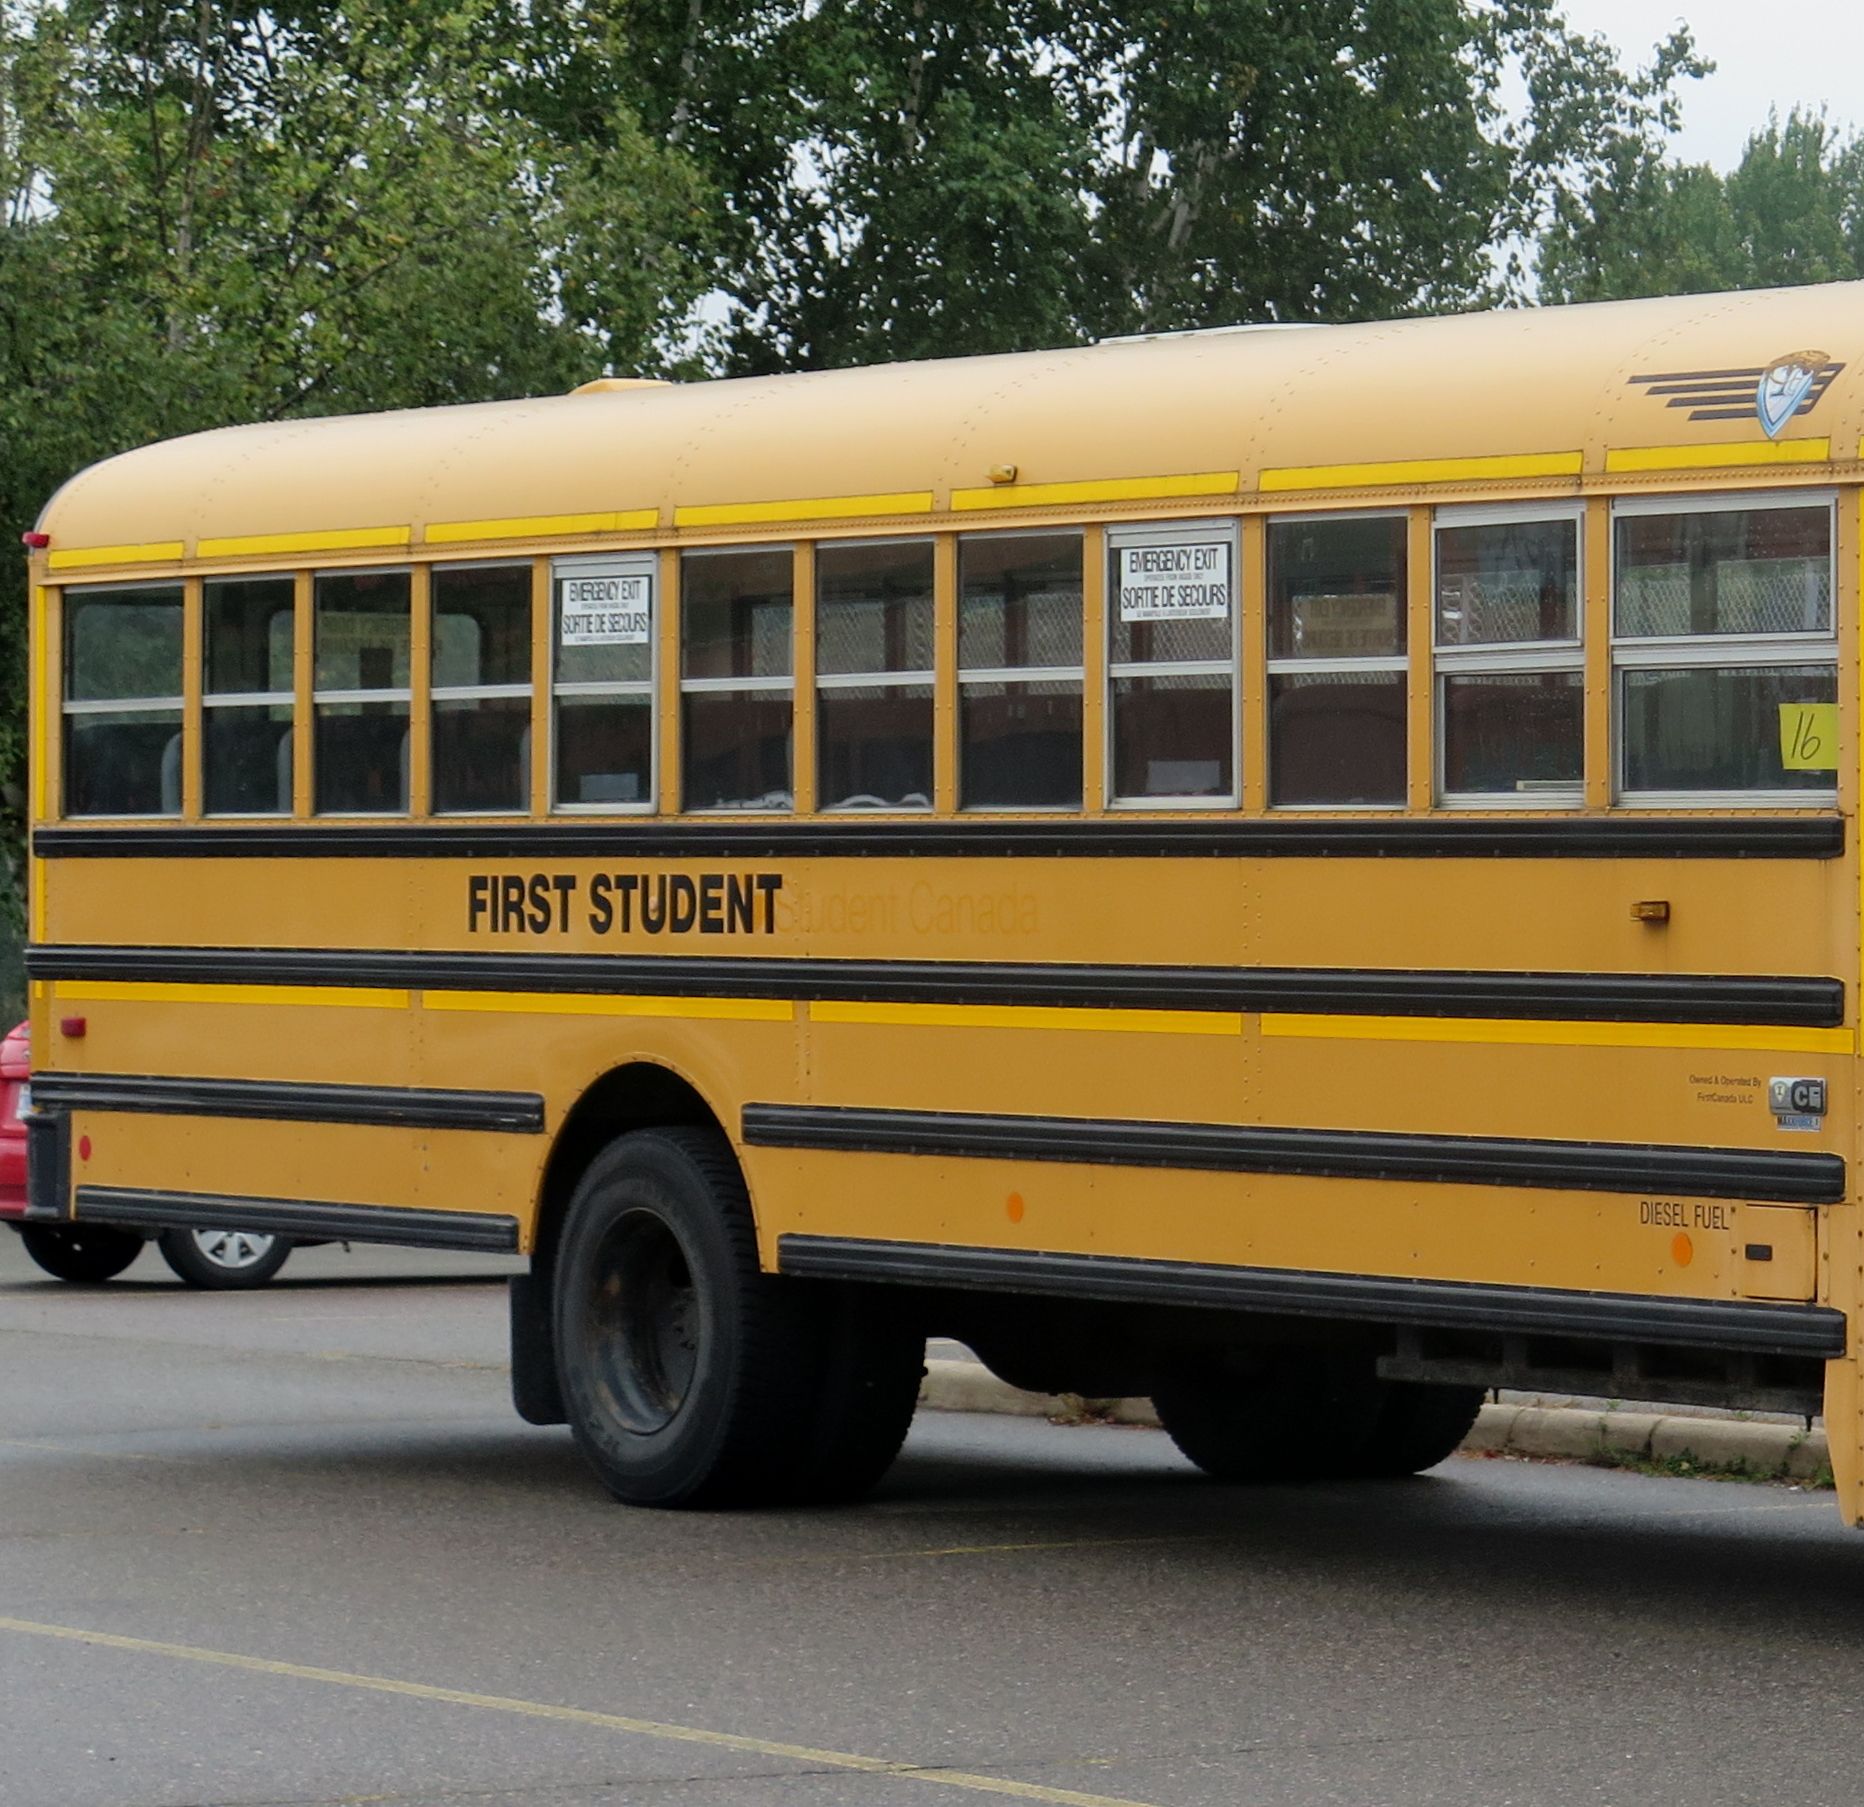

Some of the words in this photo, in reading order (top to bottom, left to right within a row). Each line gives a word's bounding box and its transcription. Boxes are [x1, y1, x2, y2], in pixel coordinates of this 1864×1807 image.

[1130, 549, 1191, 572] EMERGENCY
[1195, 548, 1218, 569] EXIT
[570, 582, 619, 601] EMERGENCY
[622, 581, 641, 599] EXIT
[1123, 586, 1159, 609] SORTIE
[1162, 585, 1175, 607] DE
[1178, 584, 1226, 606] SECOURS
[563, 614, 593, 634] SORTIE
[595, 613, 606, 633] DE
[608, 612, 646, 632] SECOURS
[1791, 711, 1821, 760] 16
[469, 873, 577, 934] FIRST
[588, 873, 782, 934] STUDENT
[909, 879, 1039, 935] Canada
[1689, 1074, 1713, 1085] Owned
[1721, 1075, 1751, 1088] Operated
[1752, 1077, 1762, 1089] By
[1641, 1201, 1689, 1227] DIESEL
[1694, 1204, 1730, 1230] FUEL
